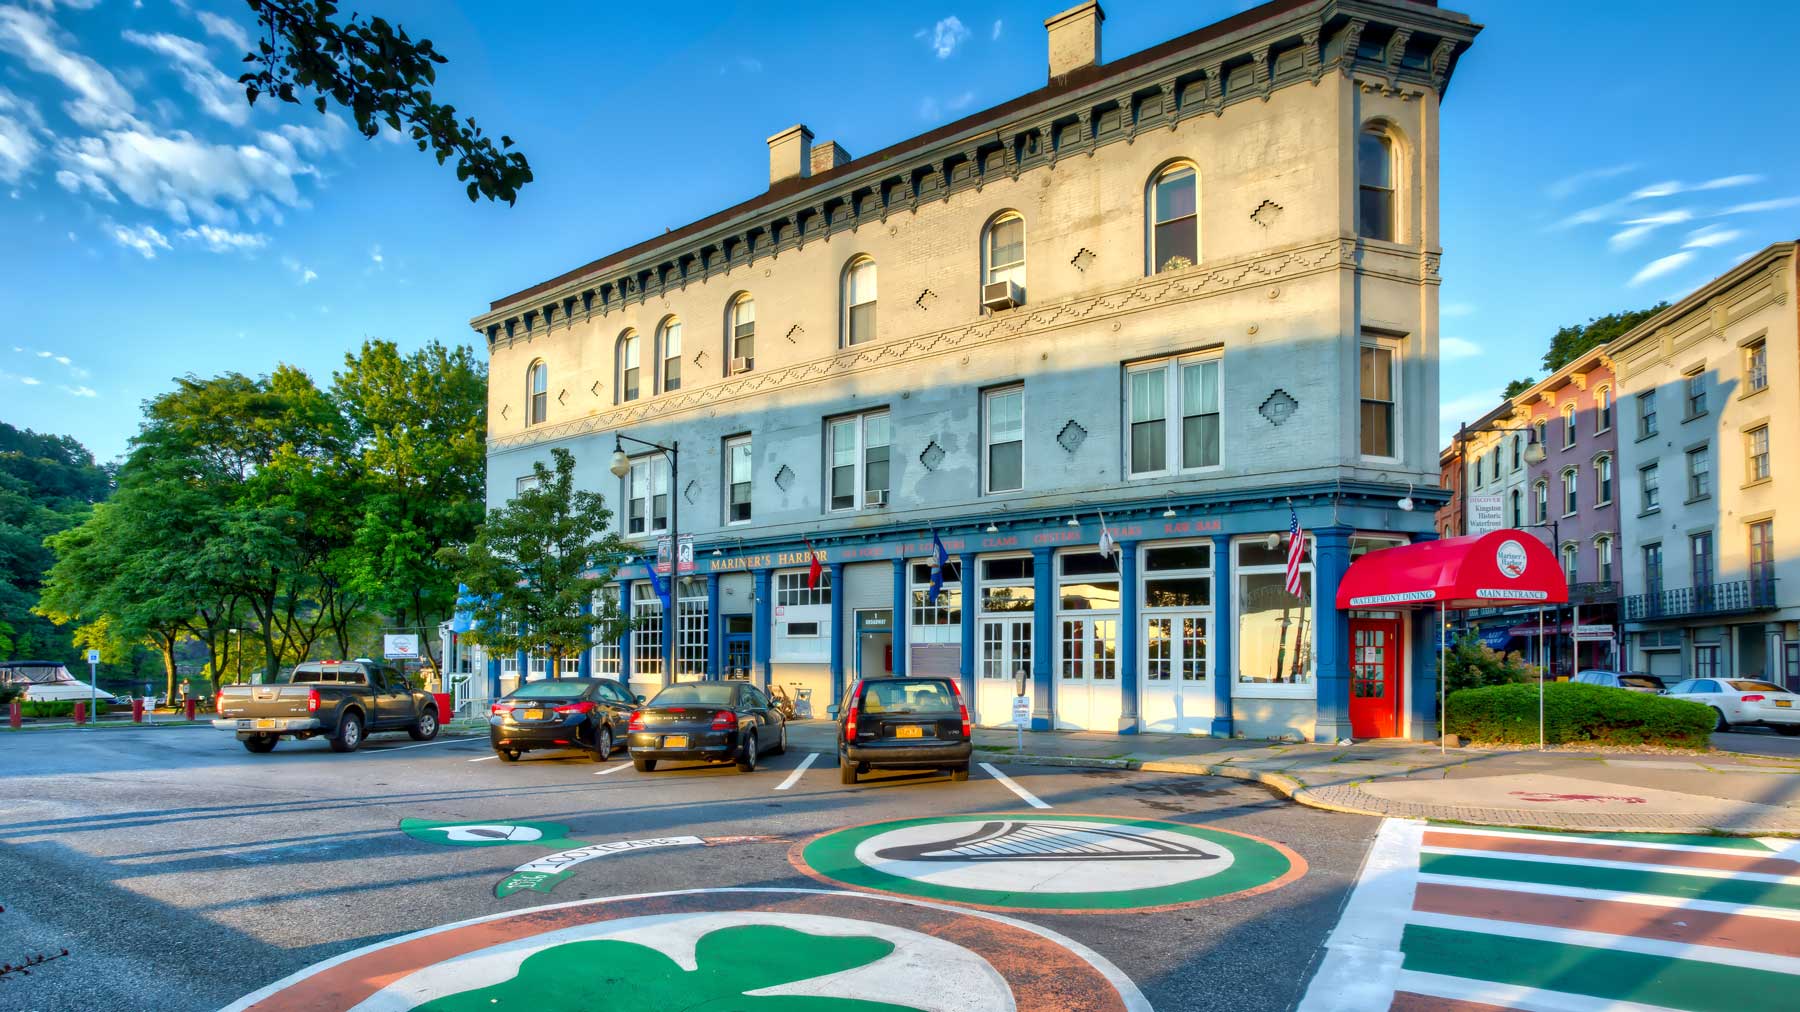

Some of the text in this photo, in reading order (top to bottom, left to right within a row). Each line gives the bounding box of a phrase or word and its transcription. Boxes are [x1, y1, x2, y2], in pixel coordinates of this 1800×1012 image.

[1475, 505, 1502, 513] Kingston
[983, 536, 1018, 547] CLAMS
[1034, 531, 1081, 545] OYSTERS
[1164, 522, 1190, 534] RAW
[1195, 519, 1221, 531] BAR
[711, 554, 771, 571] MARINER'S
[1353, 590, 1432, 605] WATERFRONT DINING
[1479, 589, 1545, 599] MAIN ENTRANCE
[530, 839, 681, 868] 100 YEARS
